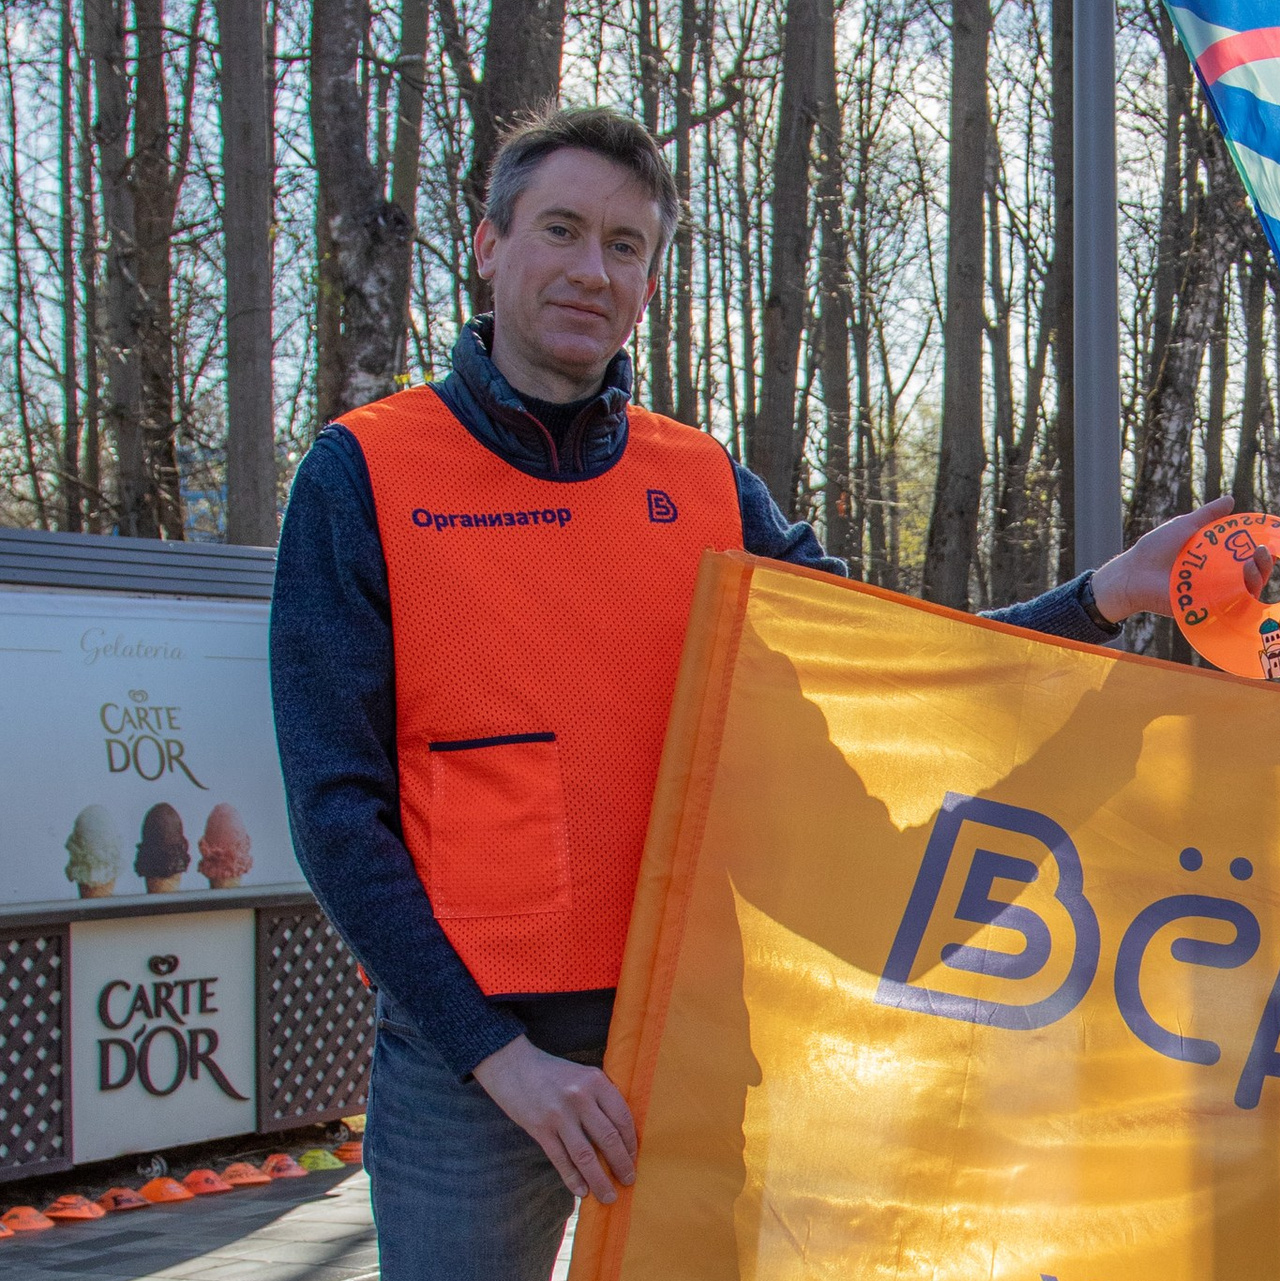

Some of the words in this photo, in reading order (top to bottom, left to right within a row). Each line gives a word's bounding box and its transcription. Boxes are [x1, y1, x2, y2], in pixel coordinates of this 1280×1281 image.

[412, 507, 572, 531] Организатор
[80, 627, 184, 666] Gelateria
[100, 702, 182, 736] CARTE
[98, 977, 219, 1030] CARTE
